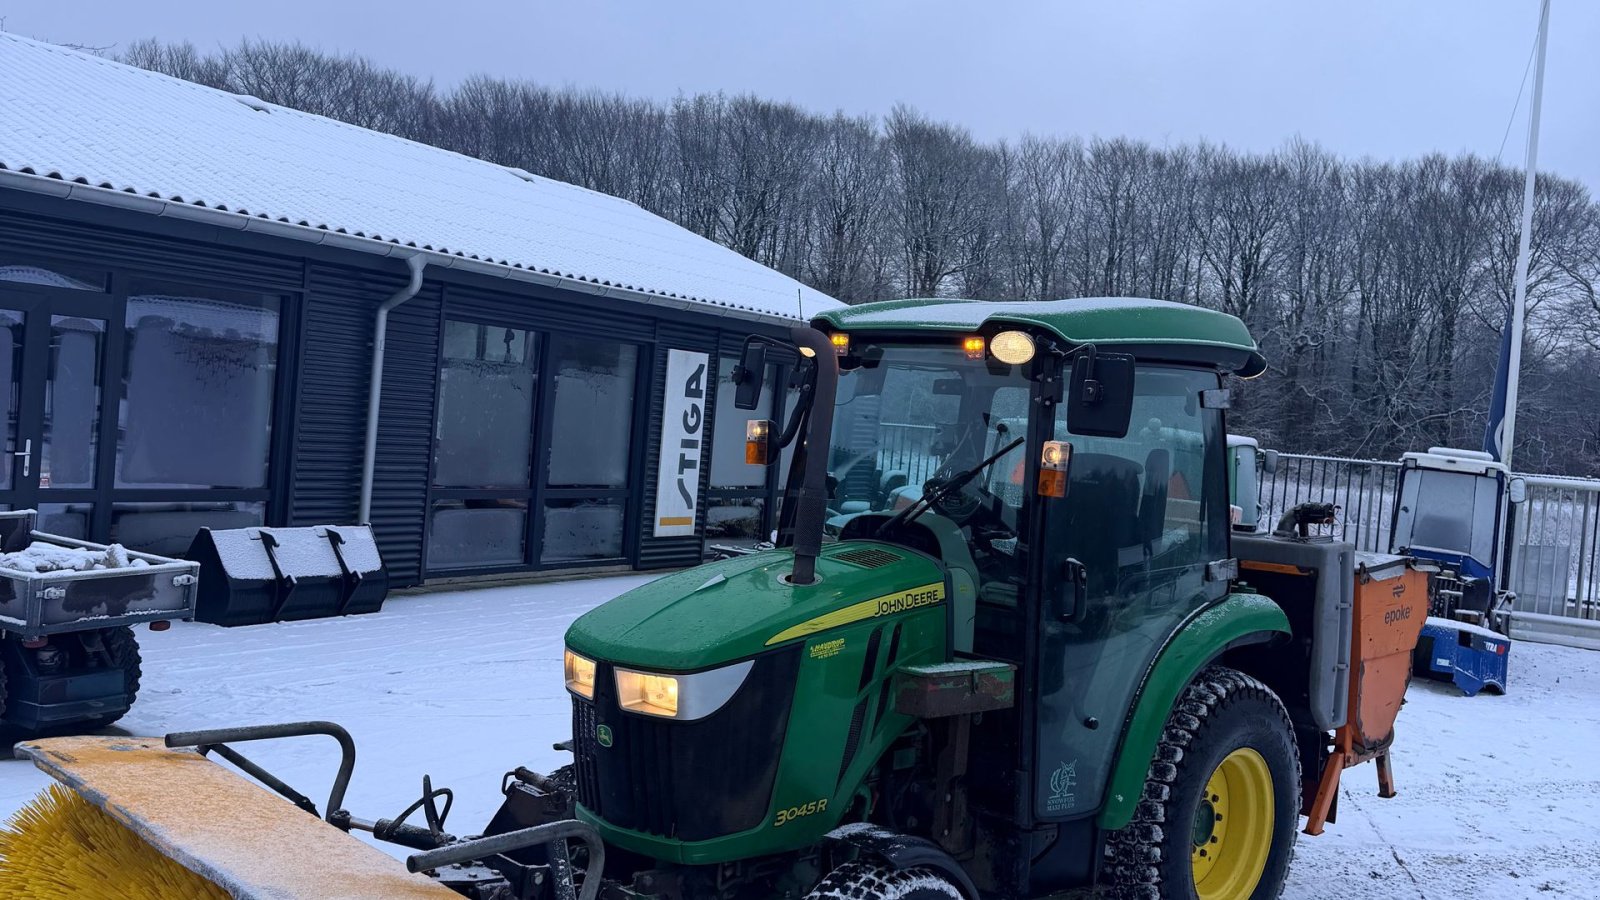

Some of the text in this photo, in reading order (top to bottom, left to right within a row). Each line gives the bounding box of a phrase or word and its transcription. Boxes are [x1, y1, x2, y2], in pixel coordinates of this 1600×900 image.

[677, 363, 706, 510] STIGA
[875, 590, 939, 616] JOHN DEERE
[1384, 605, 1411, 626] epoke
[773, 798, 828, 827] 3045R
